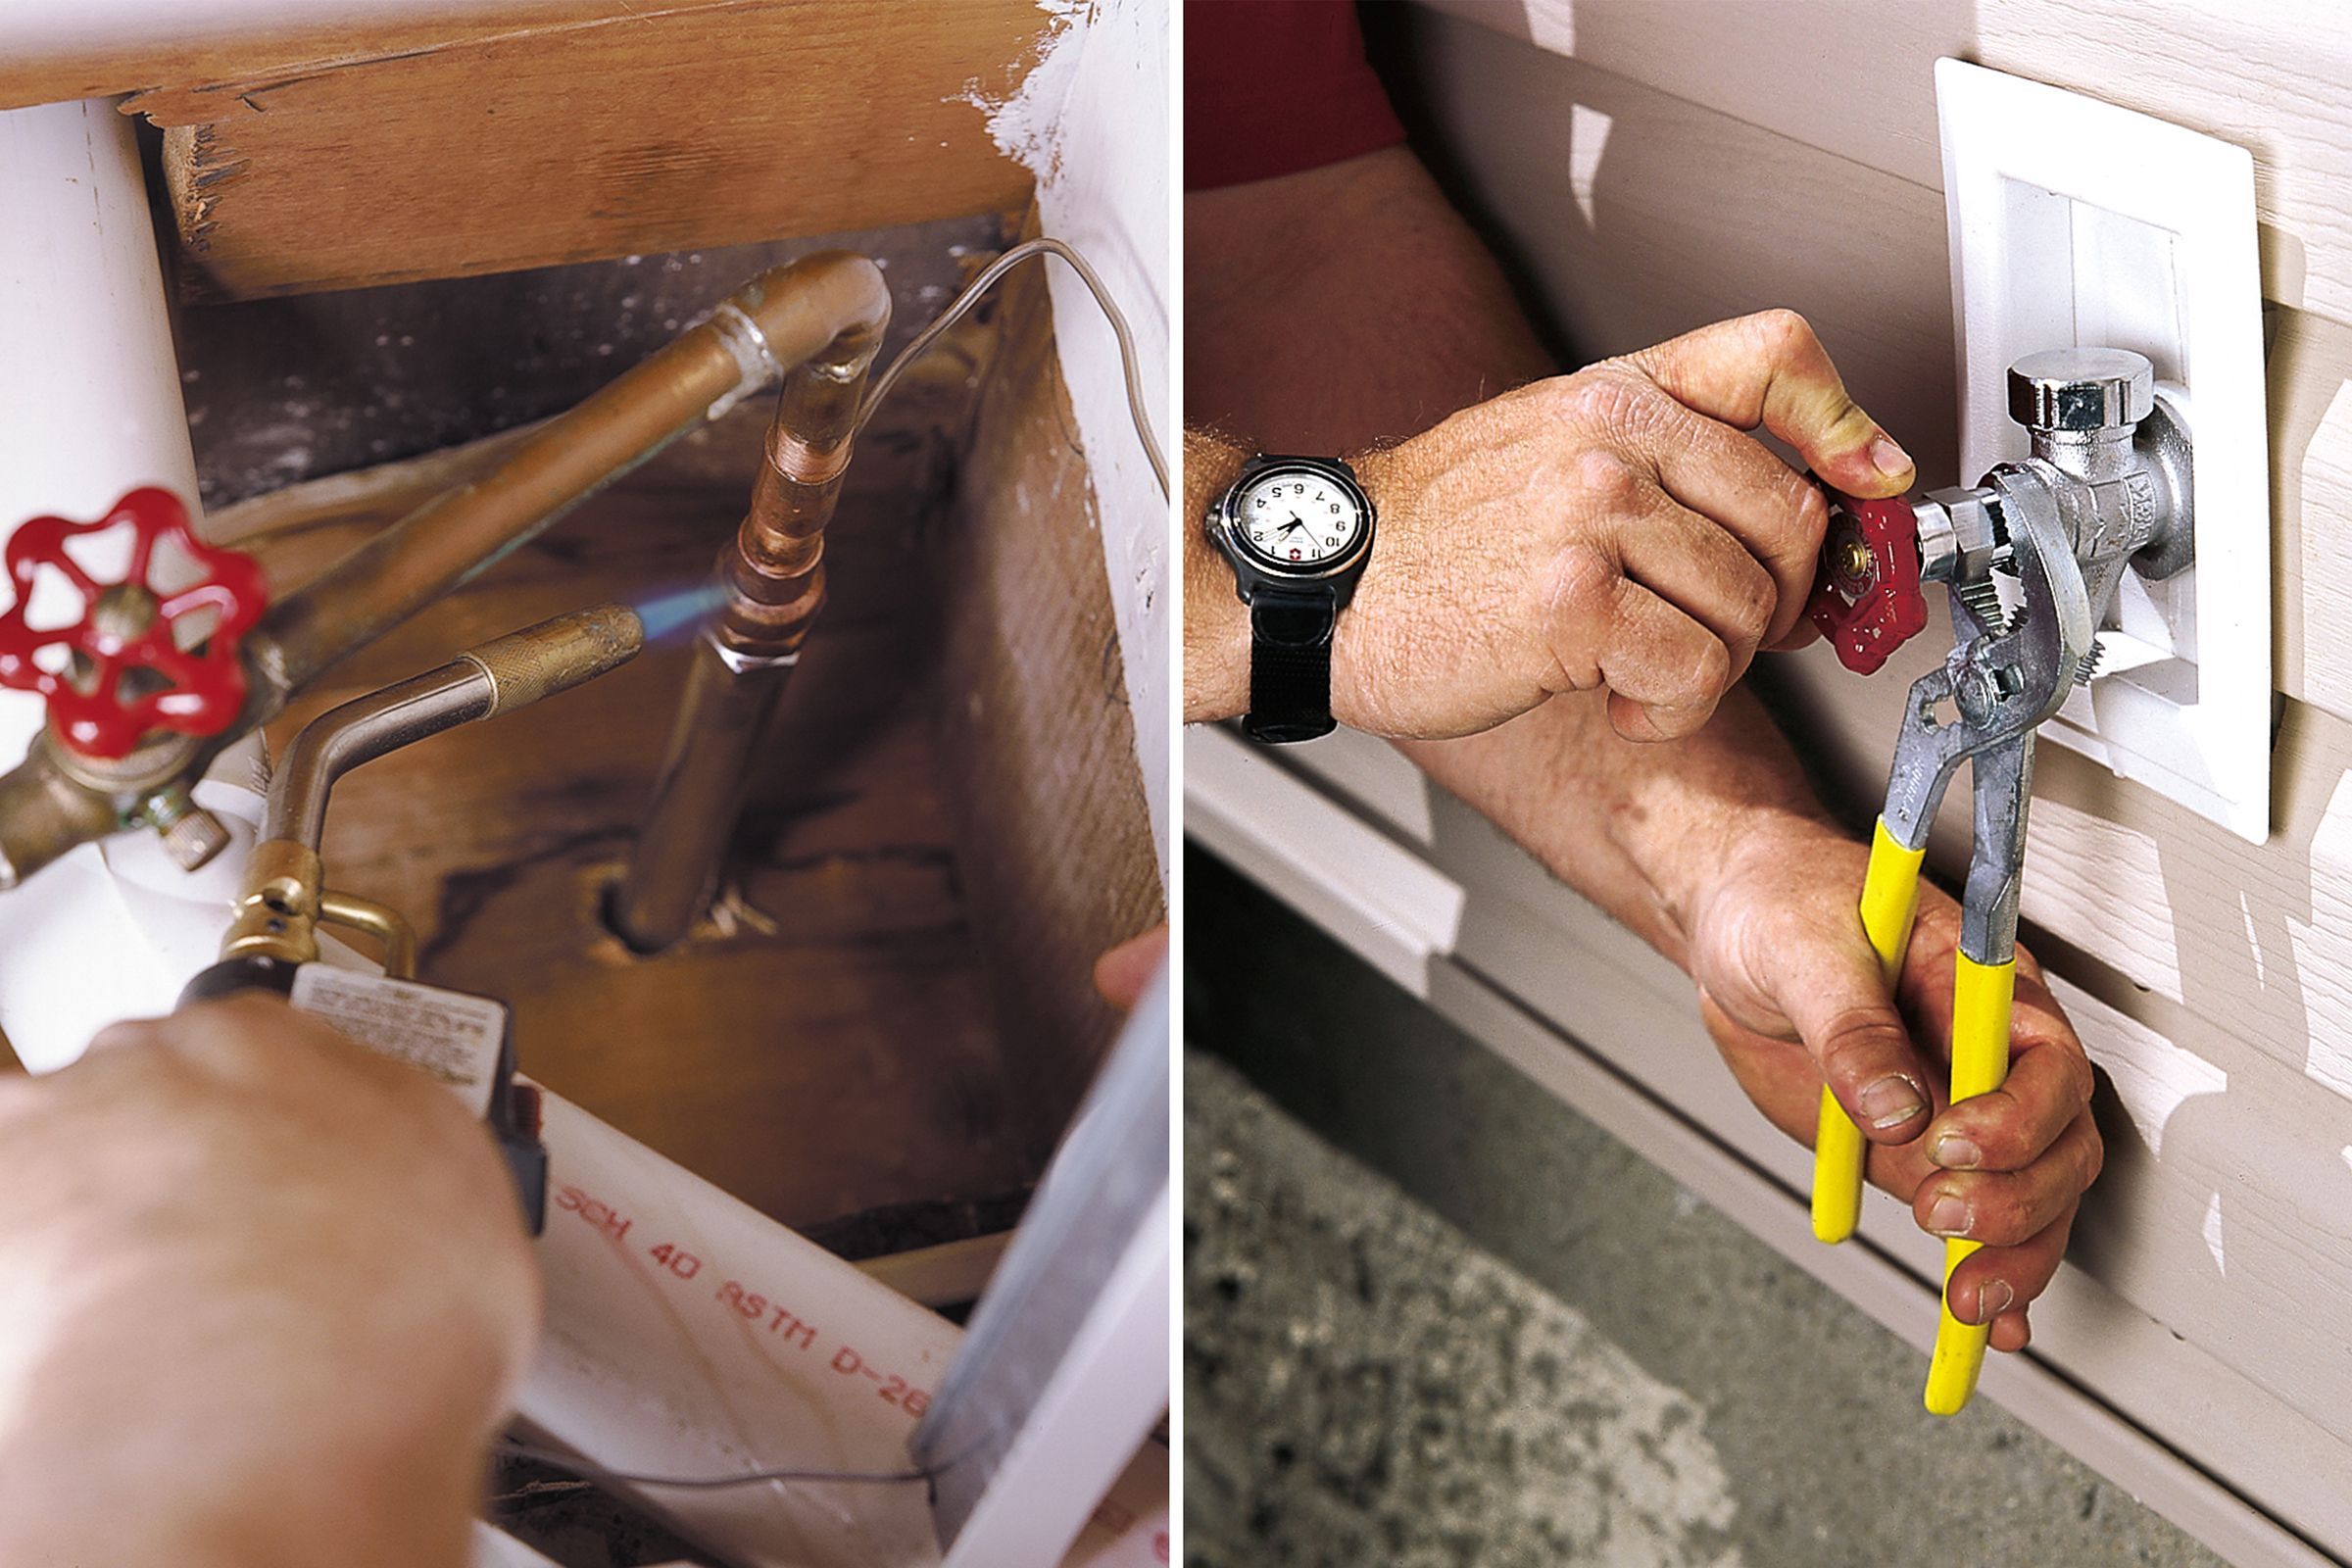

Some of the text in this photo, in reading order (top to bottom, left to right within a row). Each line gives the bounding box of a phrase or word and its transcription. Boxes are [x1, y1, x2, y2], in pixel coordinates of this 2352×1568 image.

[1272, 487, 1282, 498] 5
[1294, 483, 1304, 494] 6
[1315, 491, 1325, 502] 7
[1256, 498, 1266, 509] 4
[1330, 504, 1341, 514] 8
[1336, 521, 1346, 532] 9
[1253, 531, 1263, 542] 2
[1326, 536, 1340, 547] 10
[555, 1185, 632, 1242] SCH
[650, 1243, 703, 1280] 40
[715, 1280, 818, 1350] ASTM
